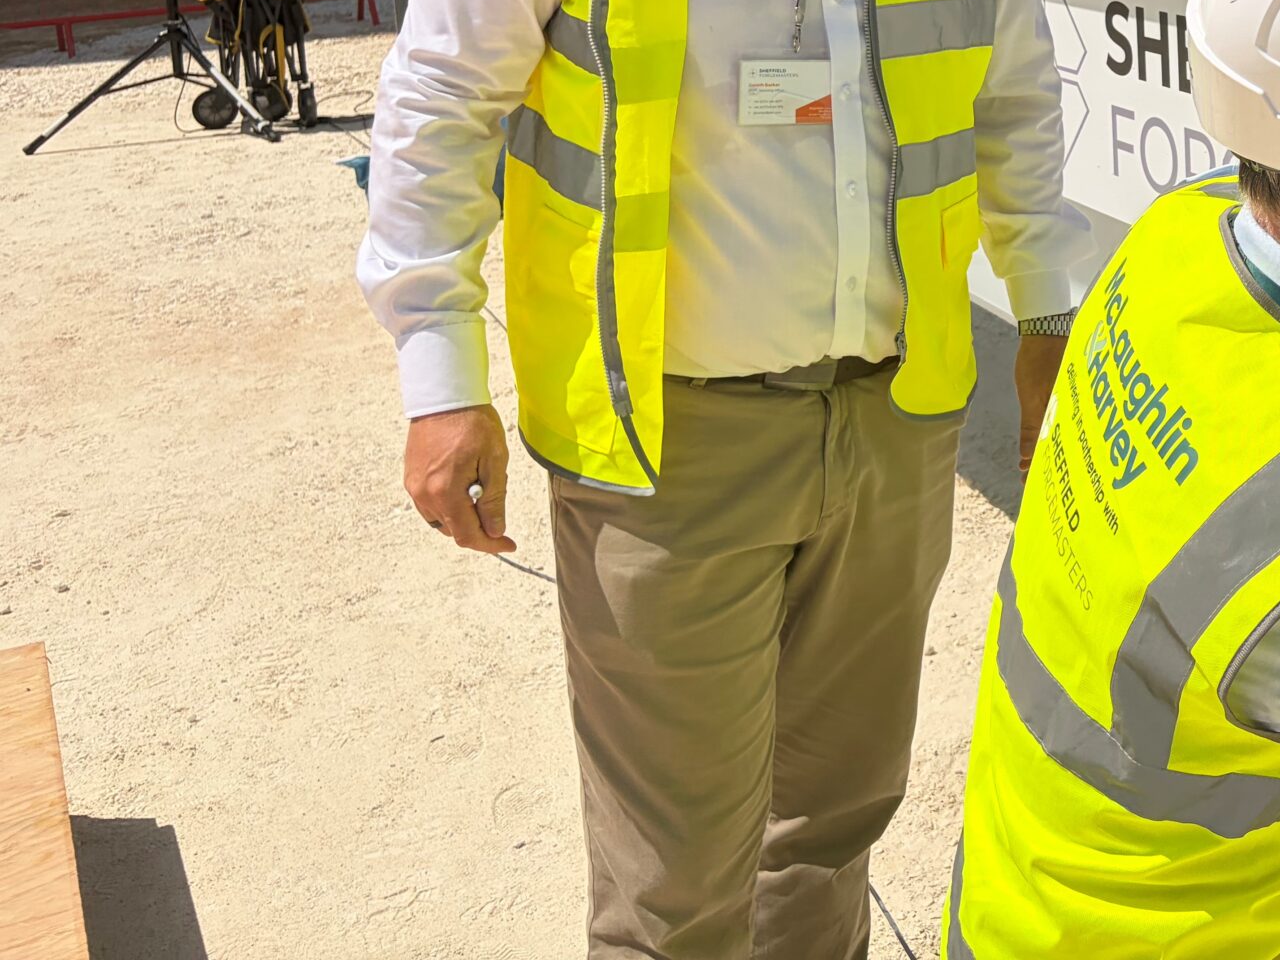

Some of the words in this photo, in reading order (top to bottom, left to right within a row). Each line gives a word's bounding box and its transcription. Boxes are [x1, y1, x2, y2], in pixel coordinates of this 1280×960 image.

[1066, 362, 1080, 421] delivering
[1078, 429, 1105, 504] partnership
[1103, 501, 1119, 536] with
[1087, 351, 1147, 490] Harvey
[1104, 257, 1199, 486] McLaughlin
[1042, 444, 1094, 611] FORGEMASTERS
[1051, 423, 1080, 533] SHEFFIELD
